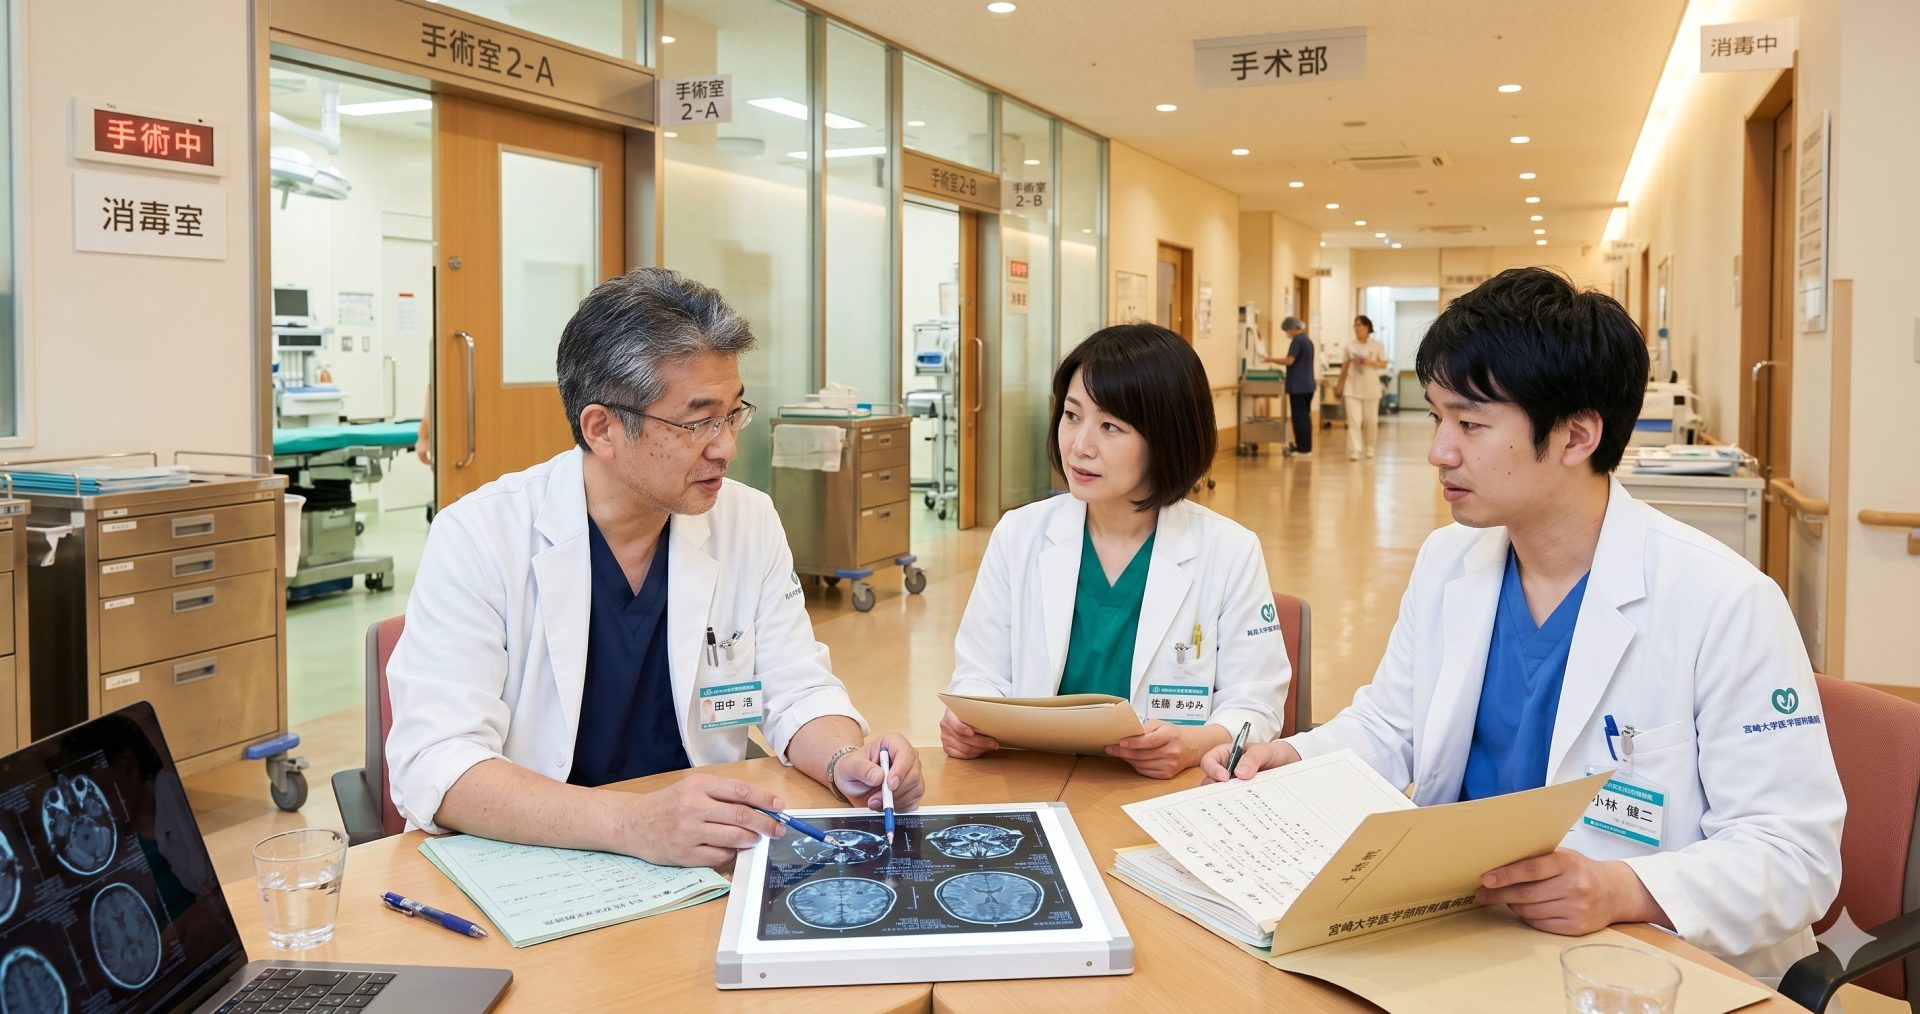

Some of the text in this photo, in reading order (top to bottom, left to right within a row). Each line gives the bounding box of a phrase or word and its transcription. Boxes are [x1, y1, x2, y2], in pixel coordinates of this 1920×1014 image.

[421, 22, 555, 88] 手術室2-A
[1710, 34, 1777, 57] 消毒中
[675, 79, 725, 101] 手術室
[681, 101, 719, 121] 2-A
[106, 118, 201, 160] 手術中
[931, 167, 977, 197] 手術室2-B
[1012, 181, 1047, 194] 手術室
[1015, 194, 1043, 207] 2-B
[102, 196, 204, 237] 消毒室
[714, 696, 753, 712] 田中 浩
[1151, 698, 1204, 710] 佐藤 あゆみ
[1592, 794, 1618, 812] 小林
